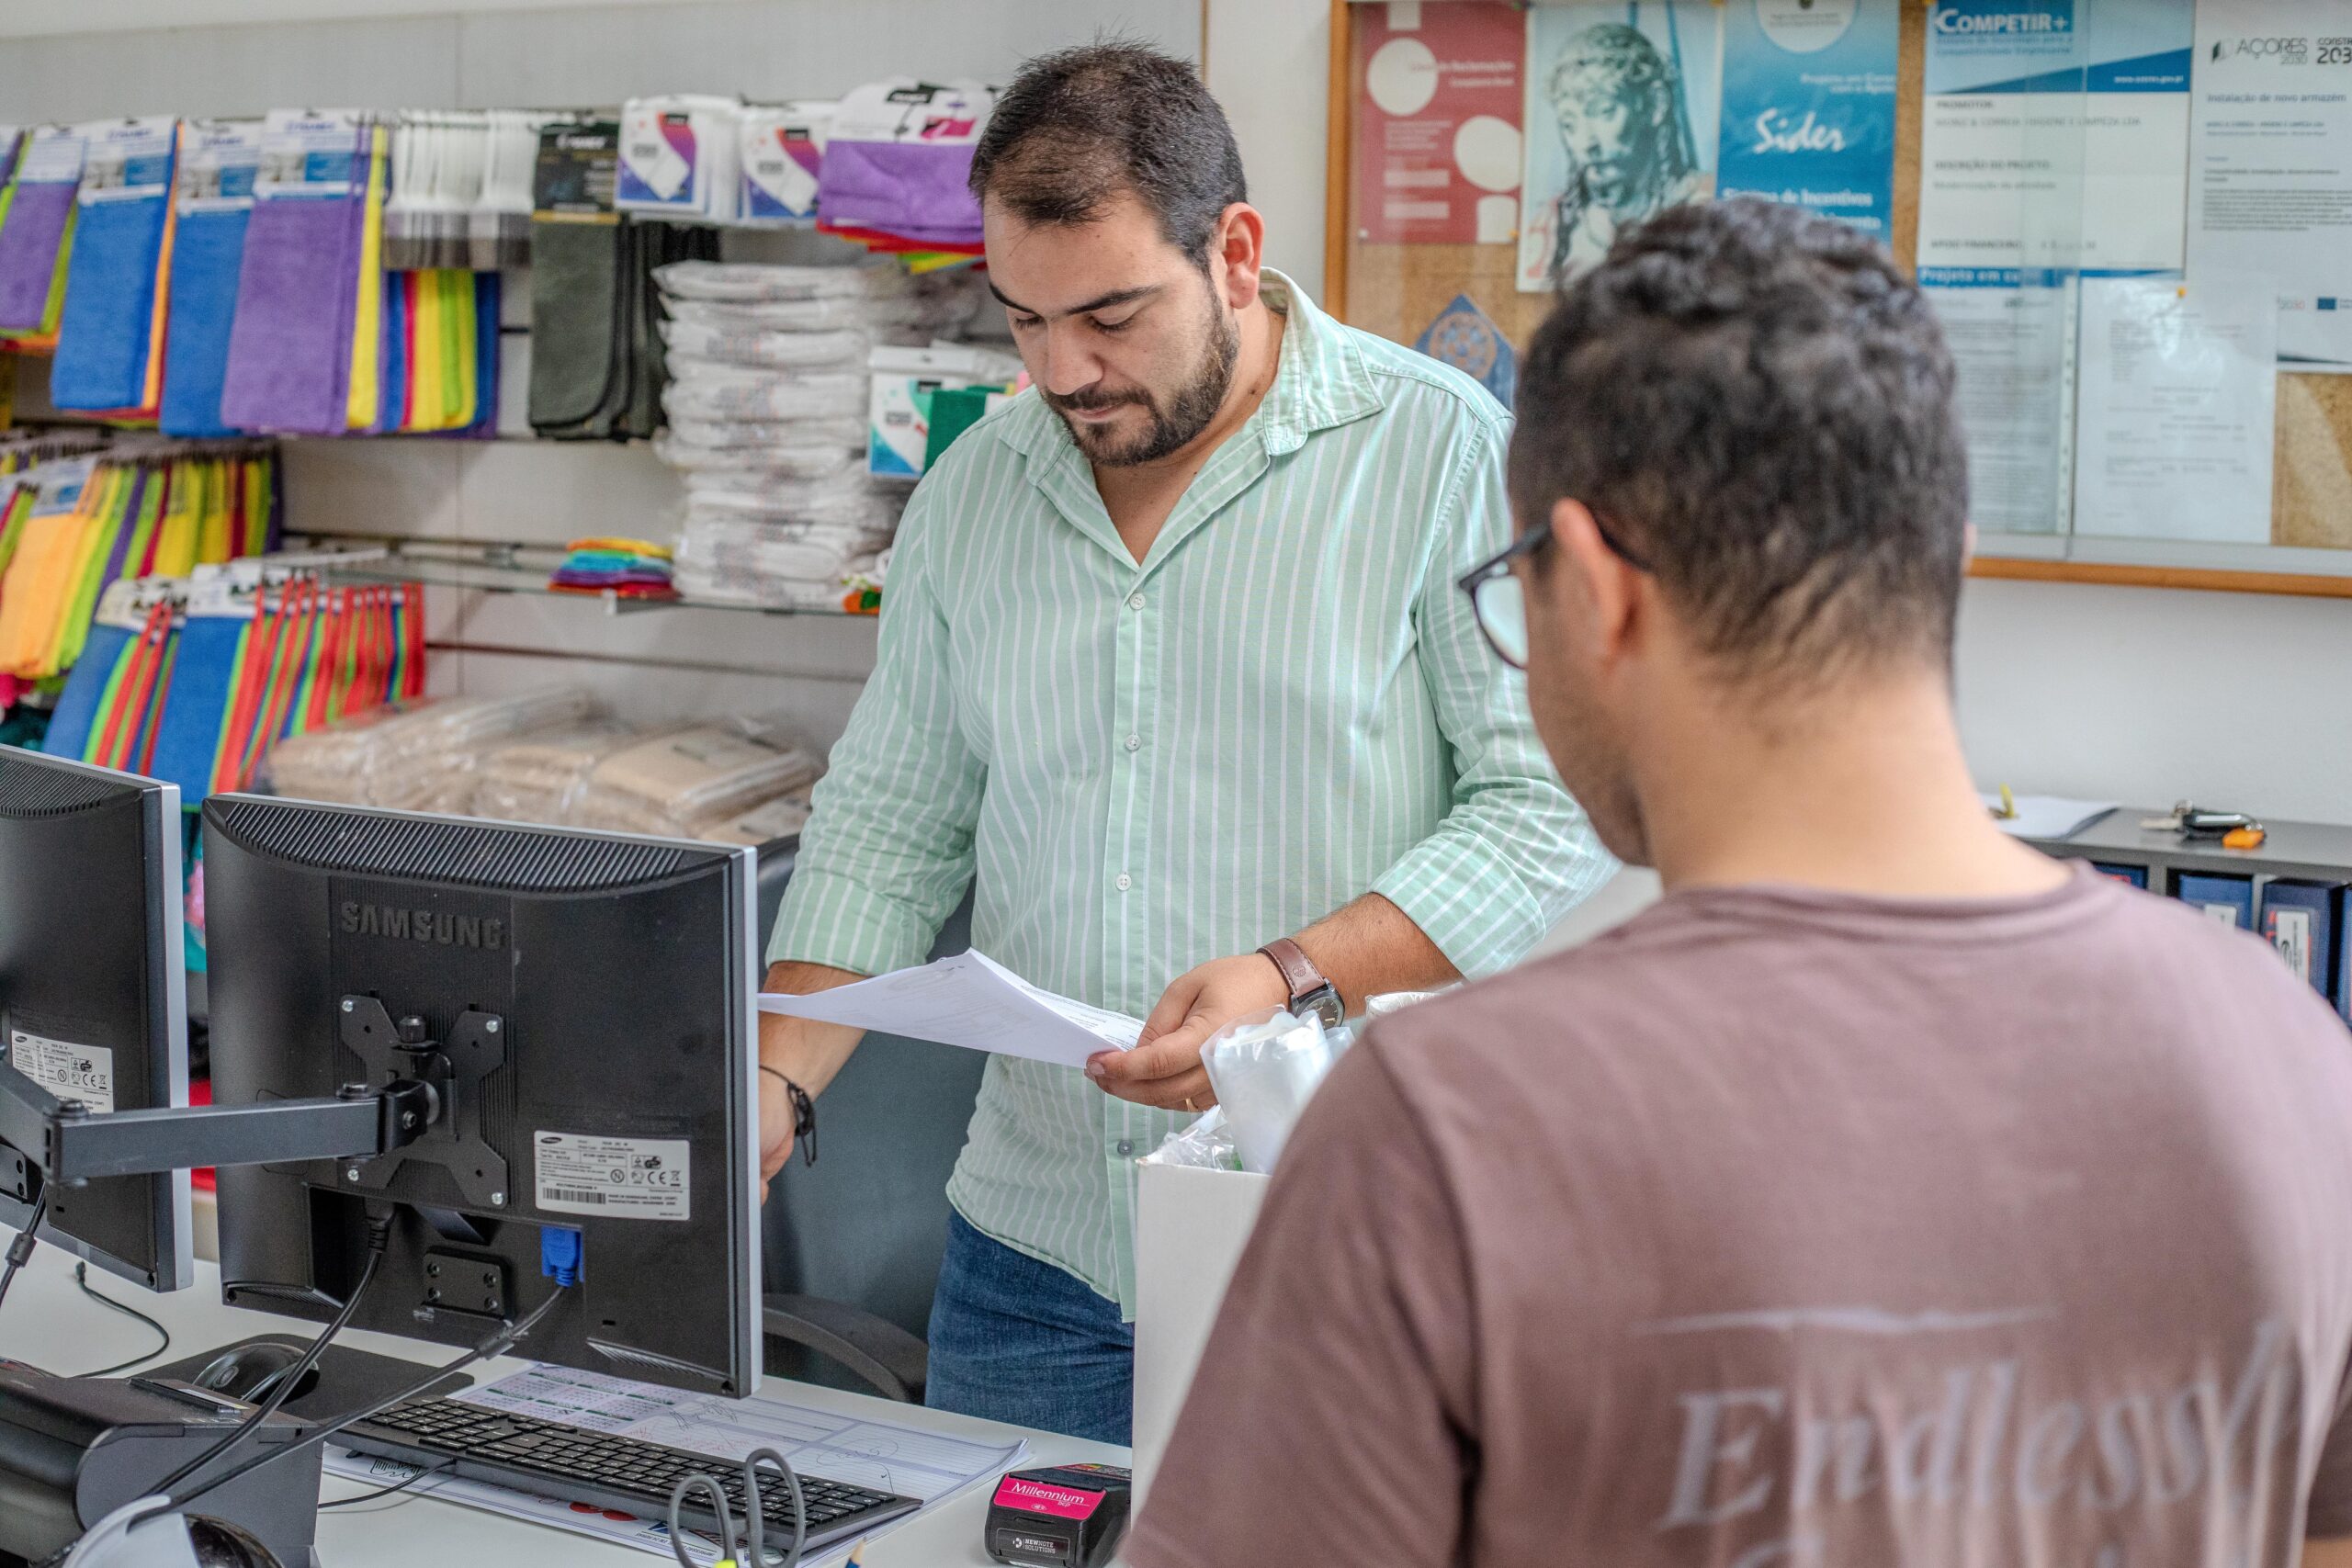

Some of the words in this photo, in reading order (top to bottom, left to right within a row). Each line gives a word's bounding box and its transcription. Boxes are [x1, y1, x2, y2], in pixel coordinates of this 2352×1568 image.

[2236, 37, 2308, 59] AÇORES
[2259, 94, 2273, 103] de
[1752, 107, 1847, 154] Sider
[341, 901, 503, 950] SAMSUNG
[1012, 1482, 1084, 1504] Millennium
[1024, 1544, 1056, 1554] SOLUTIONS
